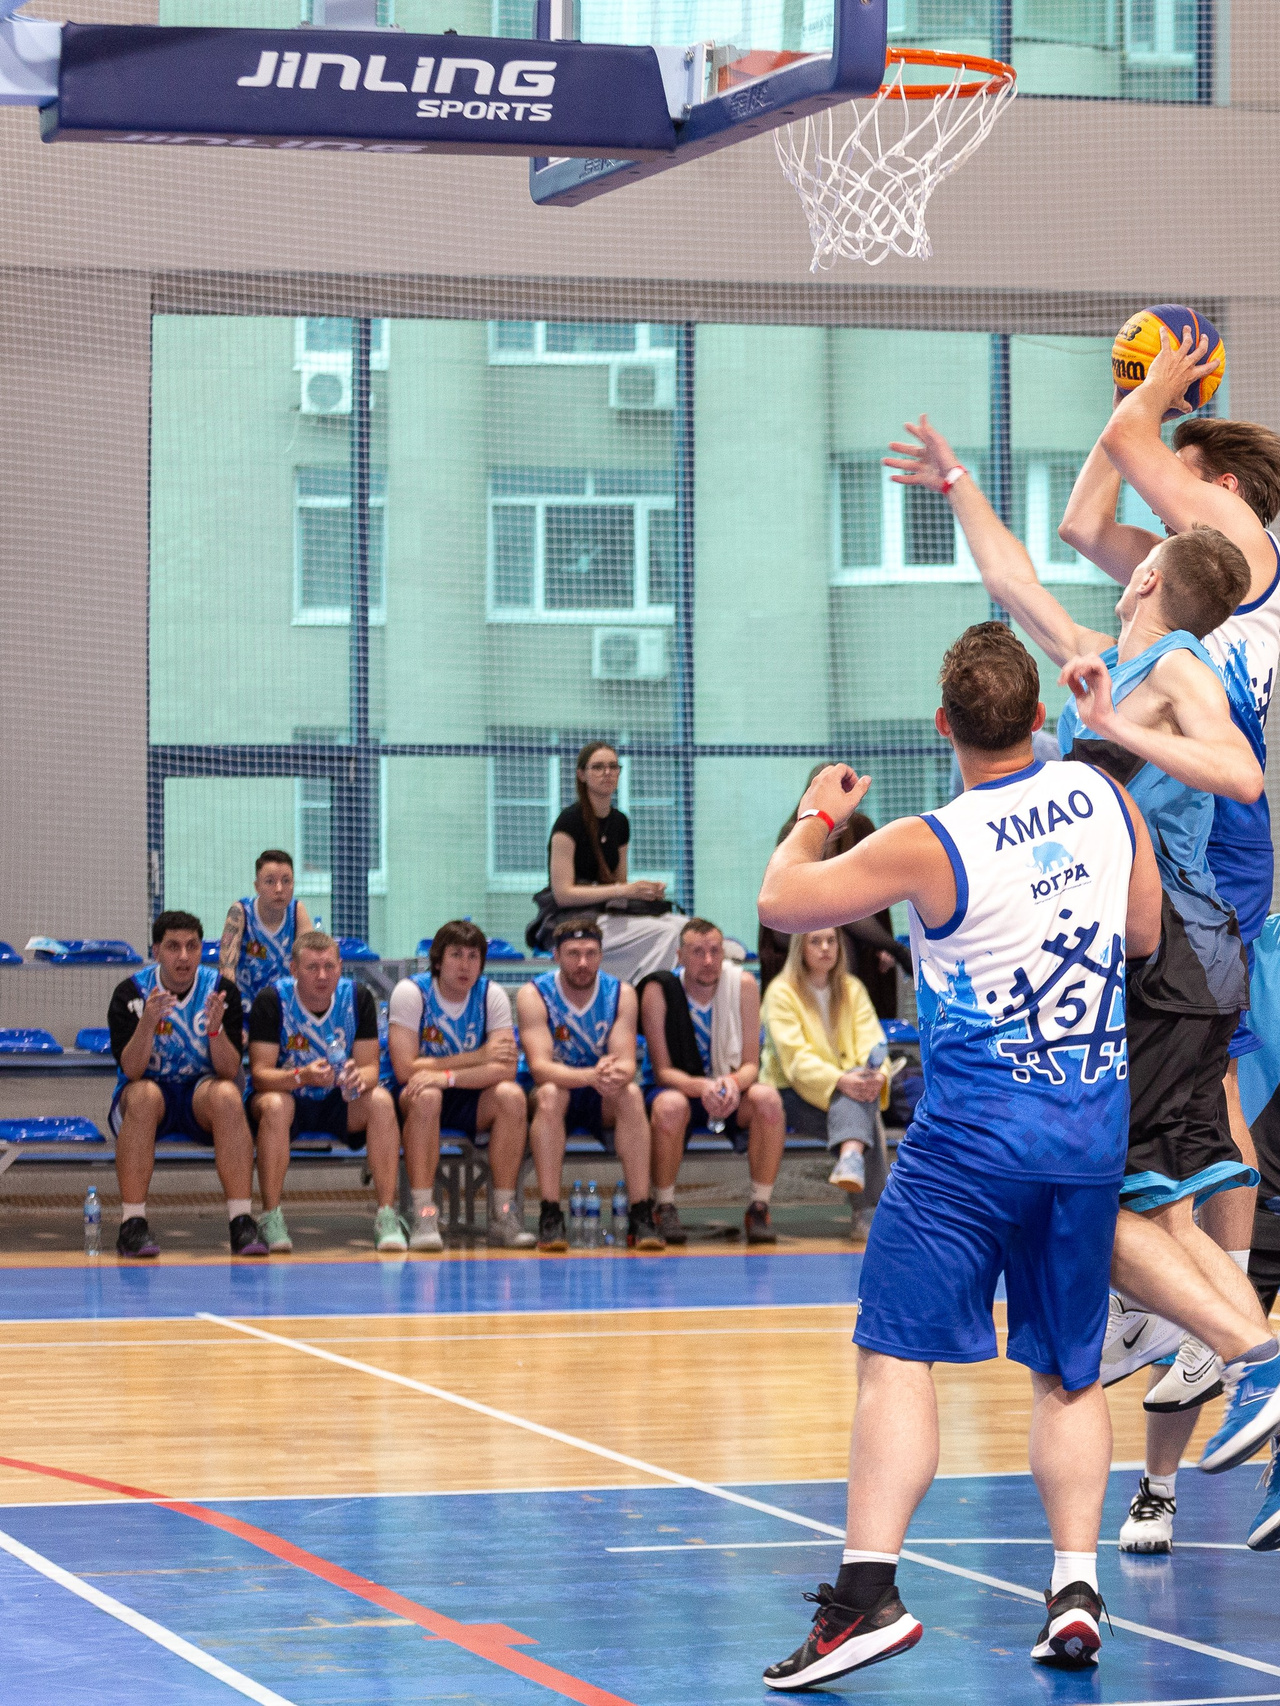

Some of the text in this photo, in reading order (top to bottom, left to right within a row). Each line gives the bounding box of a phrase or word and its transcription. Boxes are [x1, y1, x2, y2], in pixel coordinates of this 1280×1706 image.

[415, 99, 554, 122] SPORTS
[986, 789, 1094, 852] ХМАО
[1030, 863, 1091, 900] ЮГРА
[193, 1008, 209, 1037] 6
[1054, 979, 1087, 1029] 5
